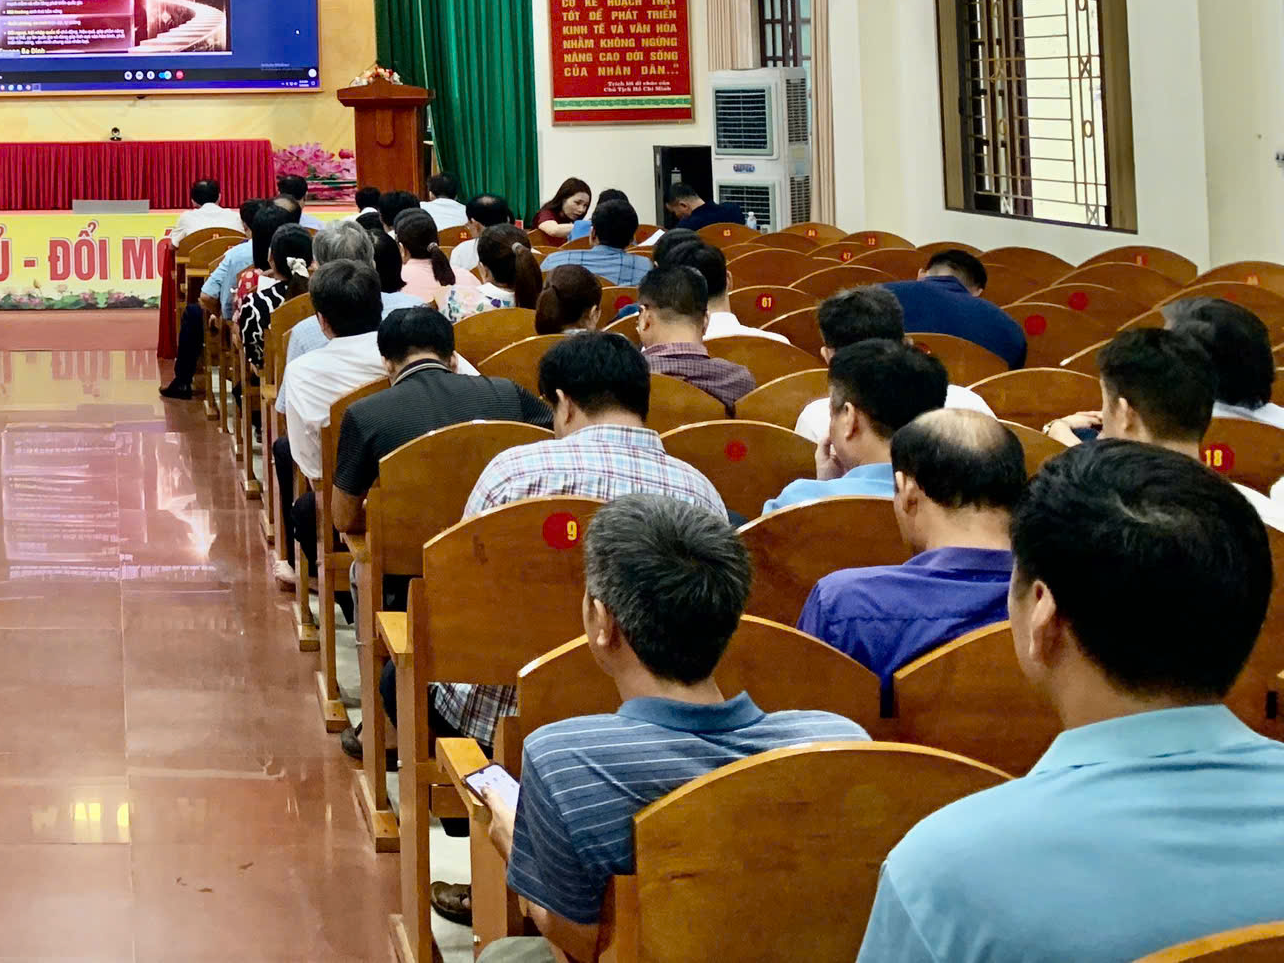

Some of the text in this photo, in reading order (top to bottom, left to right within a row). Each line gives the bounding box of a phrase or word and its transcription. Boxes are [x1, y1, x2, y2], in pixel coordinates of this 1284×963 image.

[611, 8, 638, 20] PHÁT
[562, 25, 588, 35] KINH
[610, 22, 624, 34] VÀ
[600, 37, 635, 48] KHÔNG
[563, 51, 593, 63] NÂNG
[599, 52, 620, 62] CAO
[564, 64, 588, 77] CỦA
[598, 64, 631, 77] NHÂN
[48, 221, 109, 281] ĐỔI
[566, 521, 578, 541] 9
